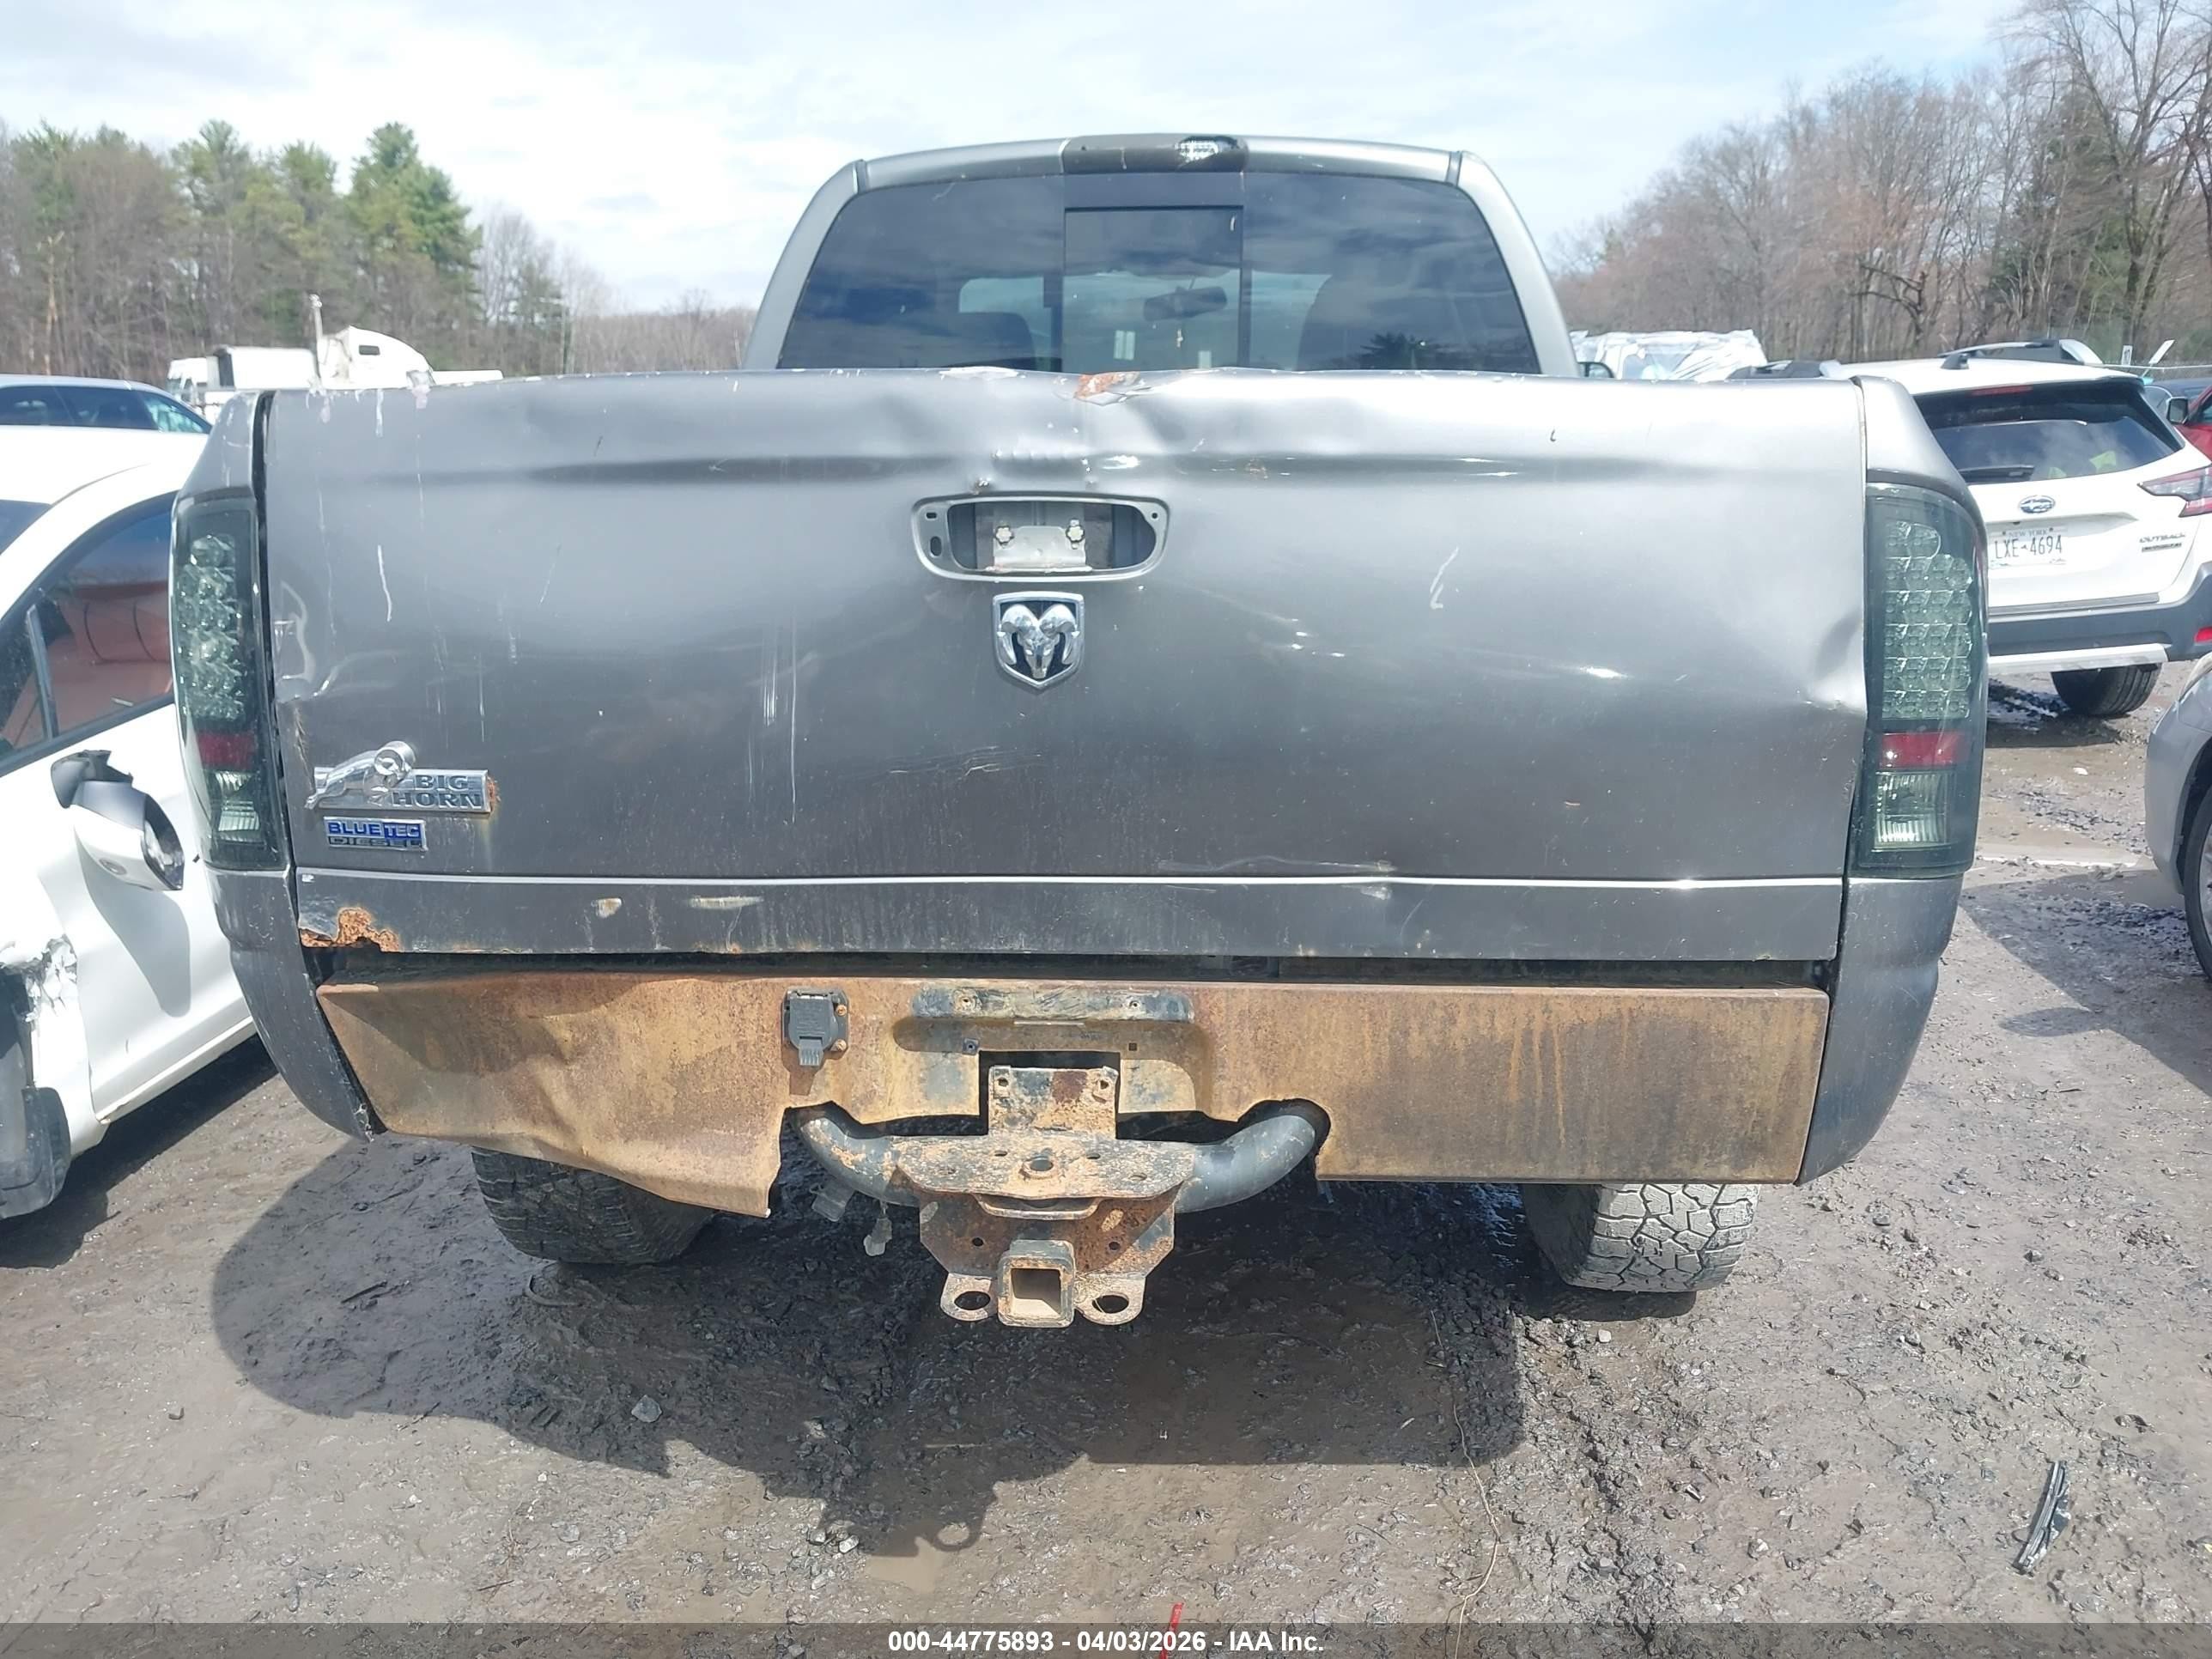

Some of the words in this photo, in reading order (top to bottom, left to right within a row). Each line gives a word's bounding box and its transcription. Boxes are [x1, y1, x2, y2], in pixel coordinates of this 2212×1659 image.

[2028, 528, 2048, 537] YORK
[414, 775, 470, 791] BIG
[392, 792, 482, 809] HORN
[328, 836, 422, 848] DIESEL
